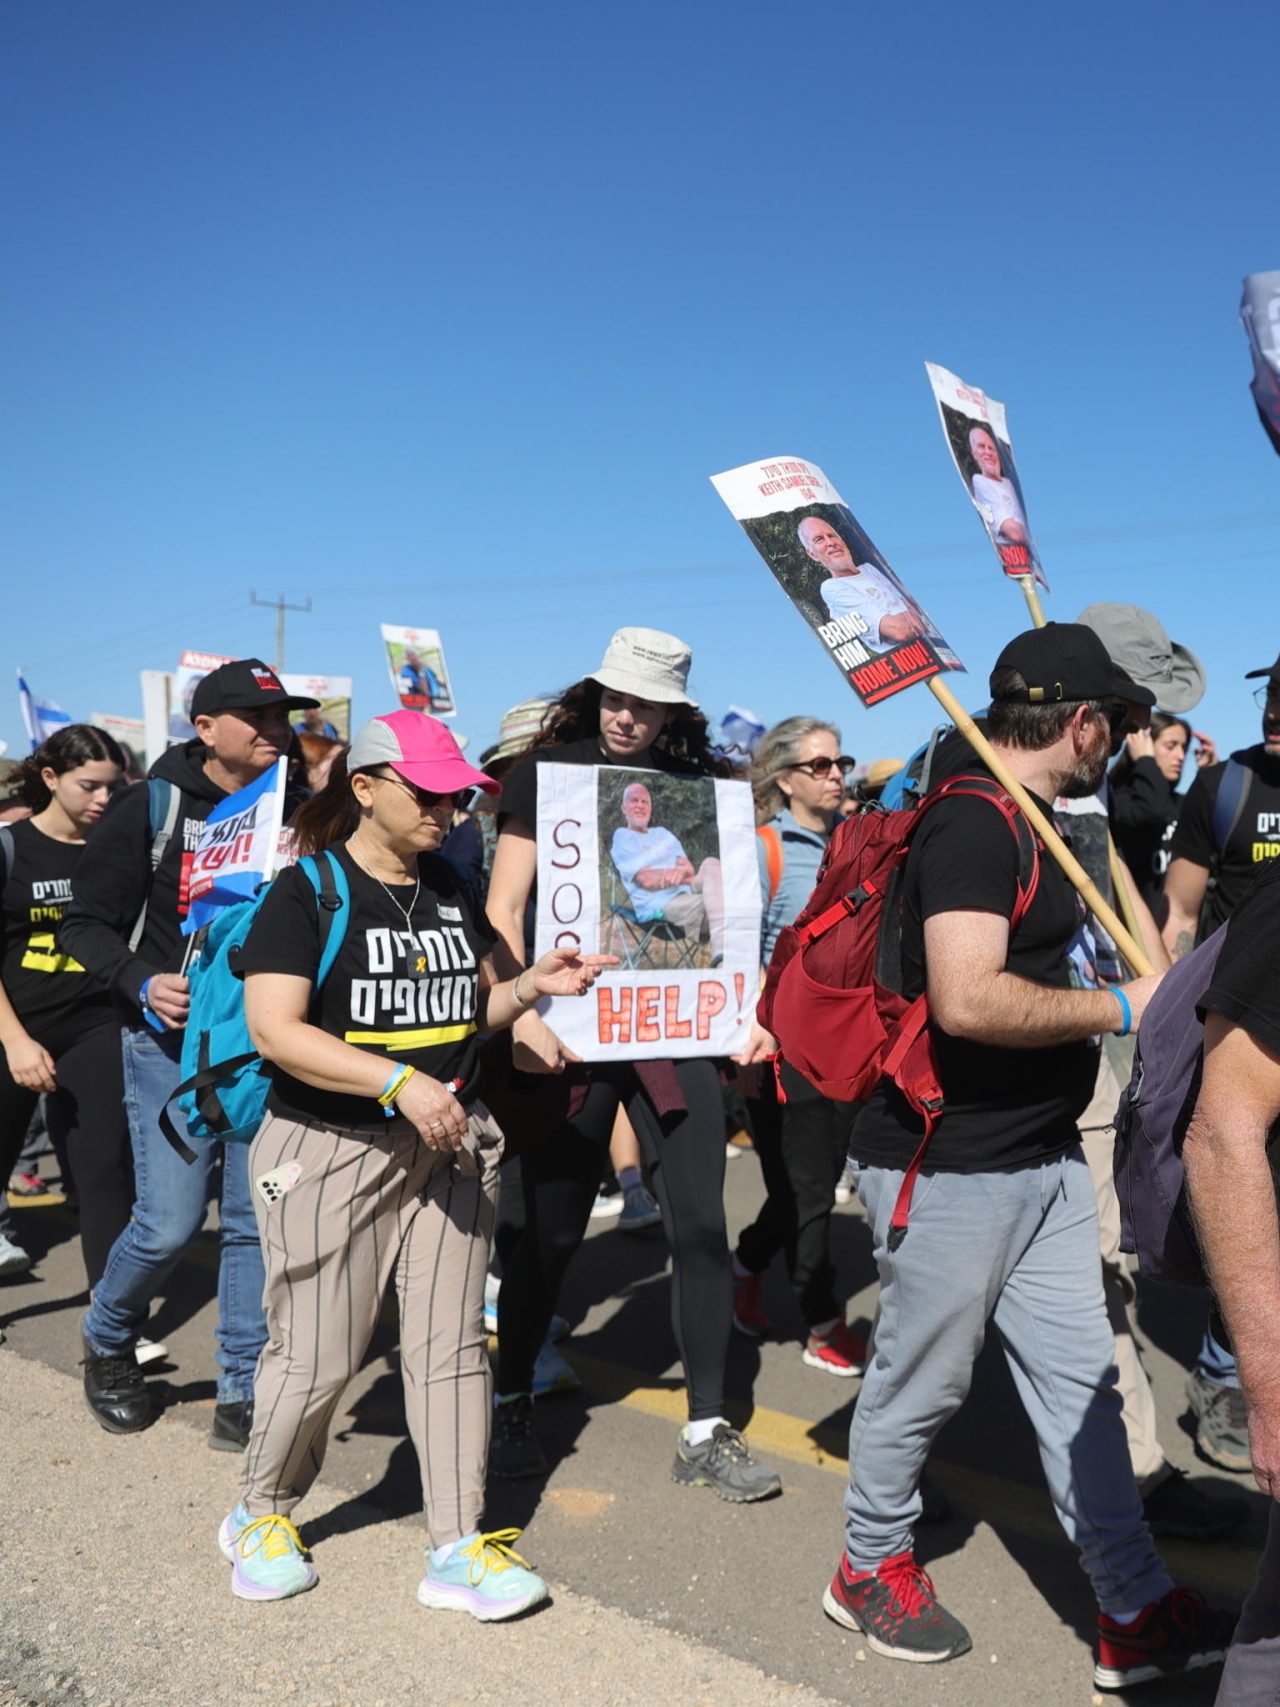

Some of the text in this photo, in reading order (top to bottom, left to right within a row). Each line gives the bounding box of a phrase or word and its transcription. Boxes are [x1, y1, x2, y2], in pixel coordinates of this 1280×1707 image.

[818, 611, 869, 649] BRING
[833, 639, 871, 671] HIM
[850, 657, 899, 695] HOME
[891, 639, 934, 675] NOW!
[597, 972, 746, 1044] HELP!
